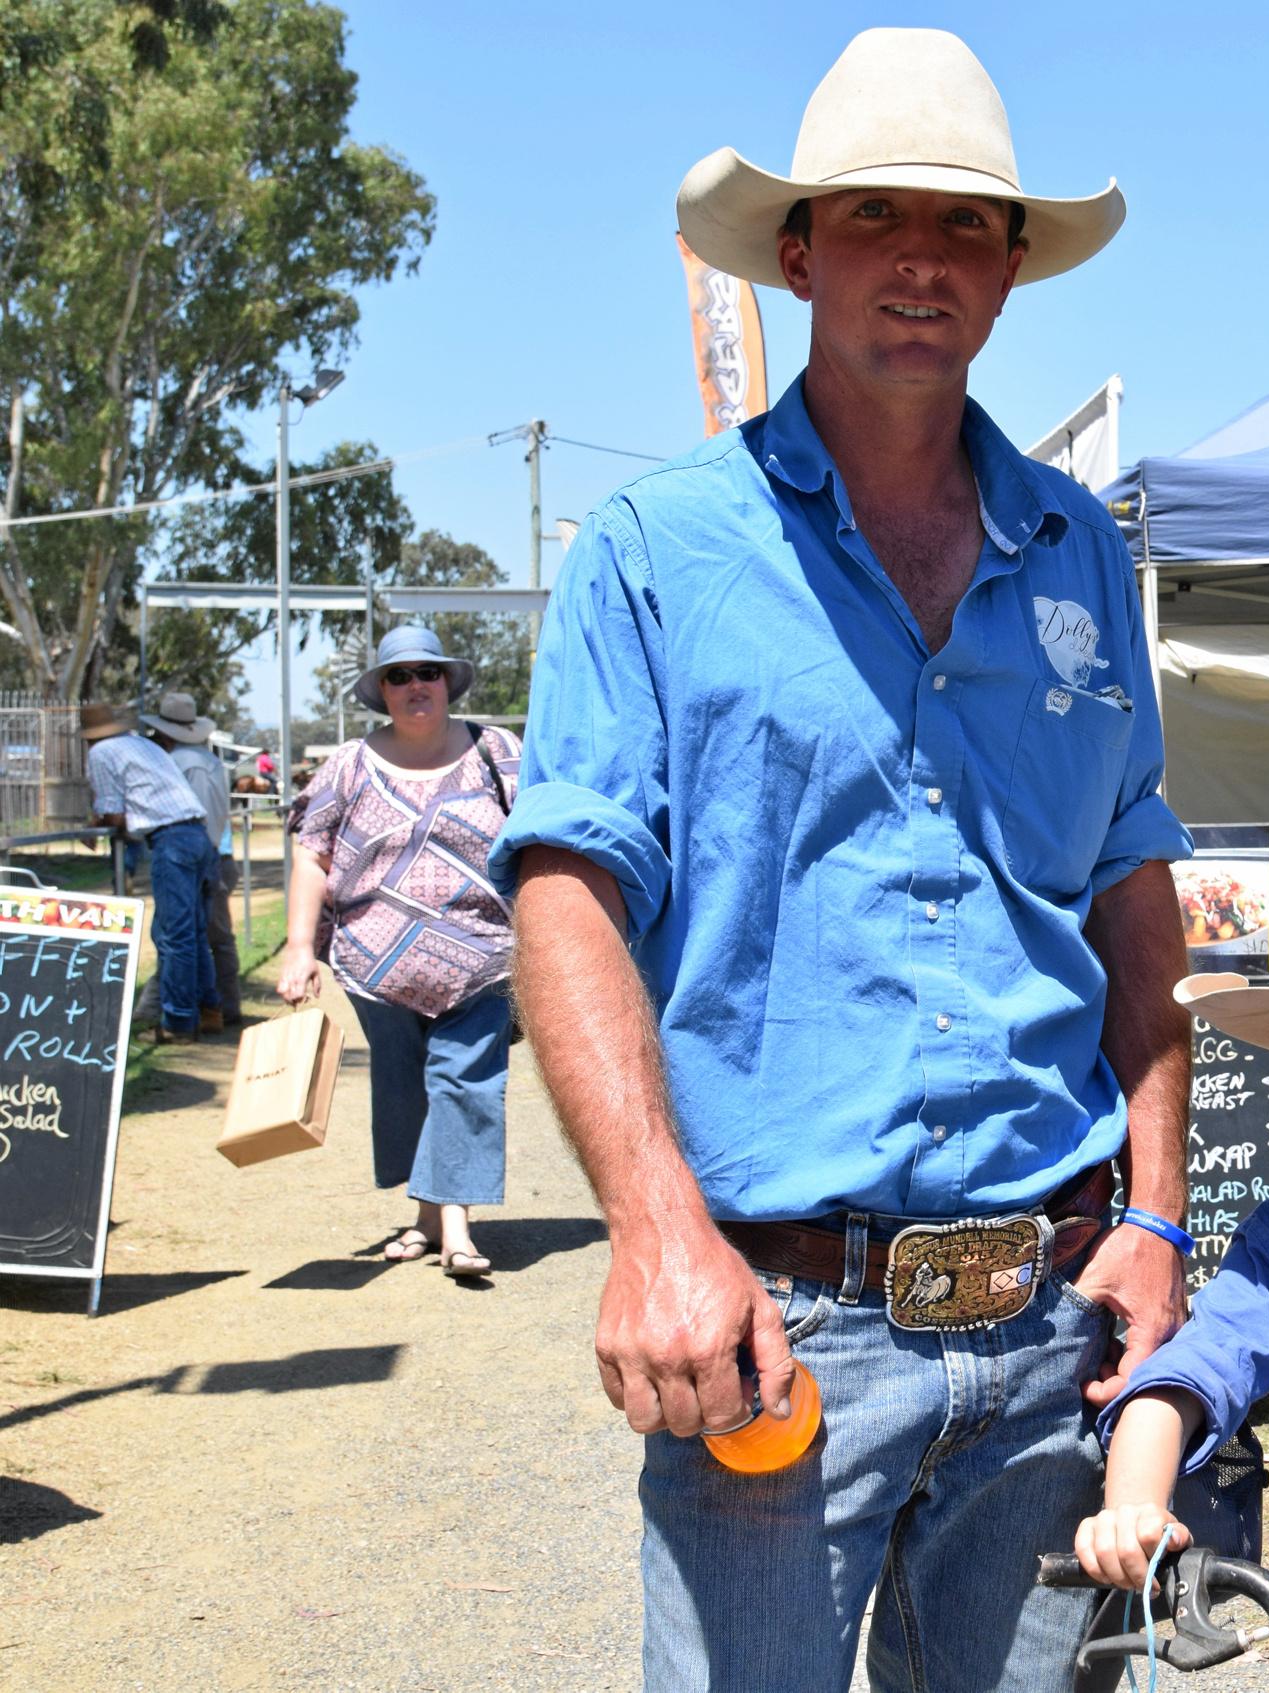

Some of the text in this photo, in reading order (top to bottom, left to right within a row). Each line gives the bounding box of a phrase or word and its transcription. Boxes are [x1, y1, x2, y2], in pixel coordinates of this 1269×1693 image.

[59, 904, 126, 928] VAN
[3, 1029, 118, 1073] ROLLS
[1188, 1141, 1257, 1174] WRAP
[1188, 1179, 1248, 1204] SALAD
[981, 1230, 1023, 1244] MEMORIAL
